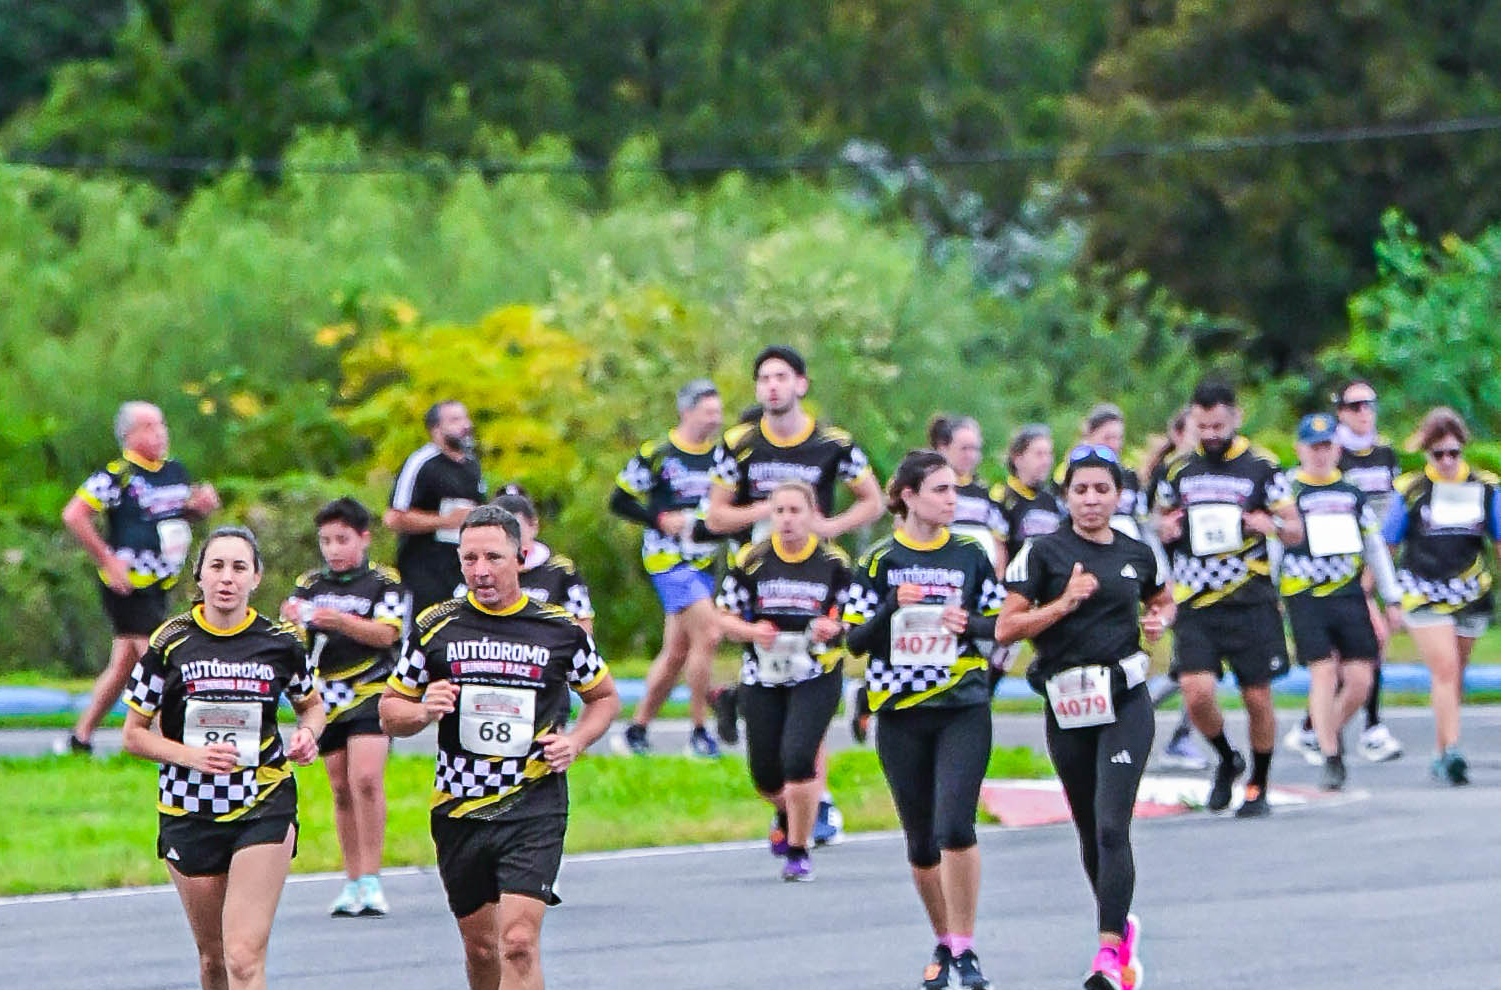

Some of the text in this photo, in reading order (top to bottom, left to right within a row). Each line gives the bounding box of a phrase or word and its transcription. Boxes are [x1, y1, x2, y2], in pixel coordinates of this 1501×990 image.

[447, 636, 550, 666] AUTÓDROMO
[895, 635, 953, 655] 4077
[181, 658, 274, 682] AUTÓDROMO
[1056, 695, 1107, 718] 4079
[479, 721, 511, 743] 68
